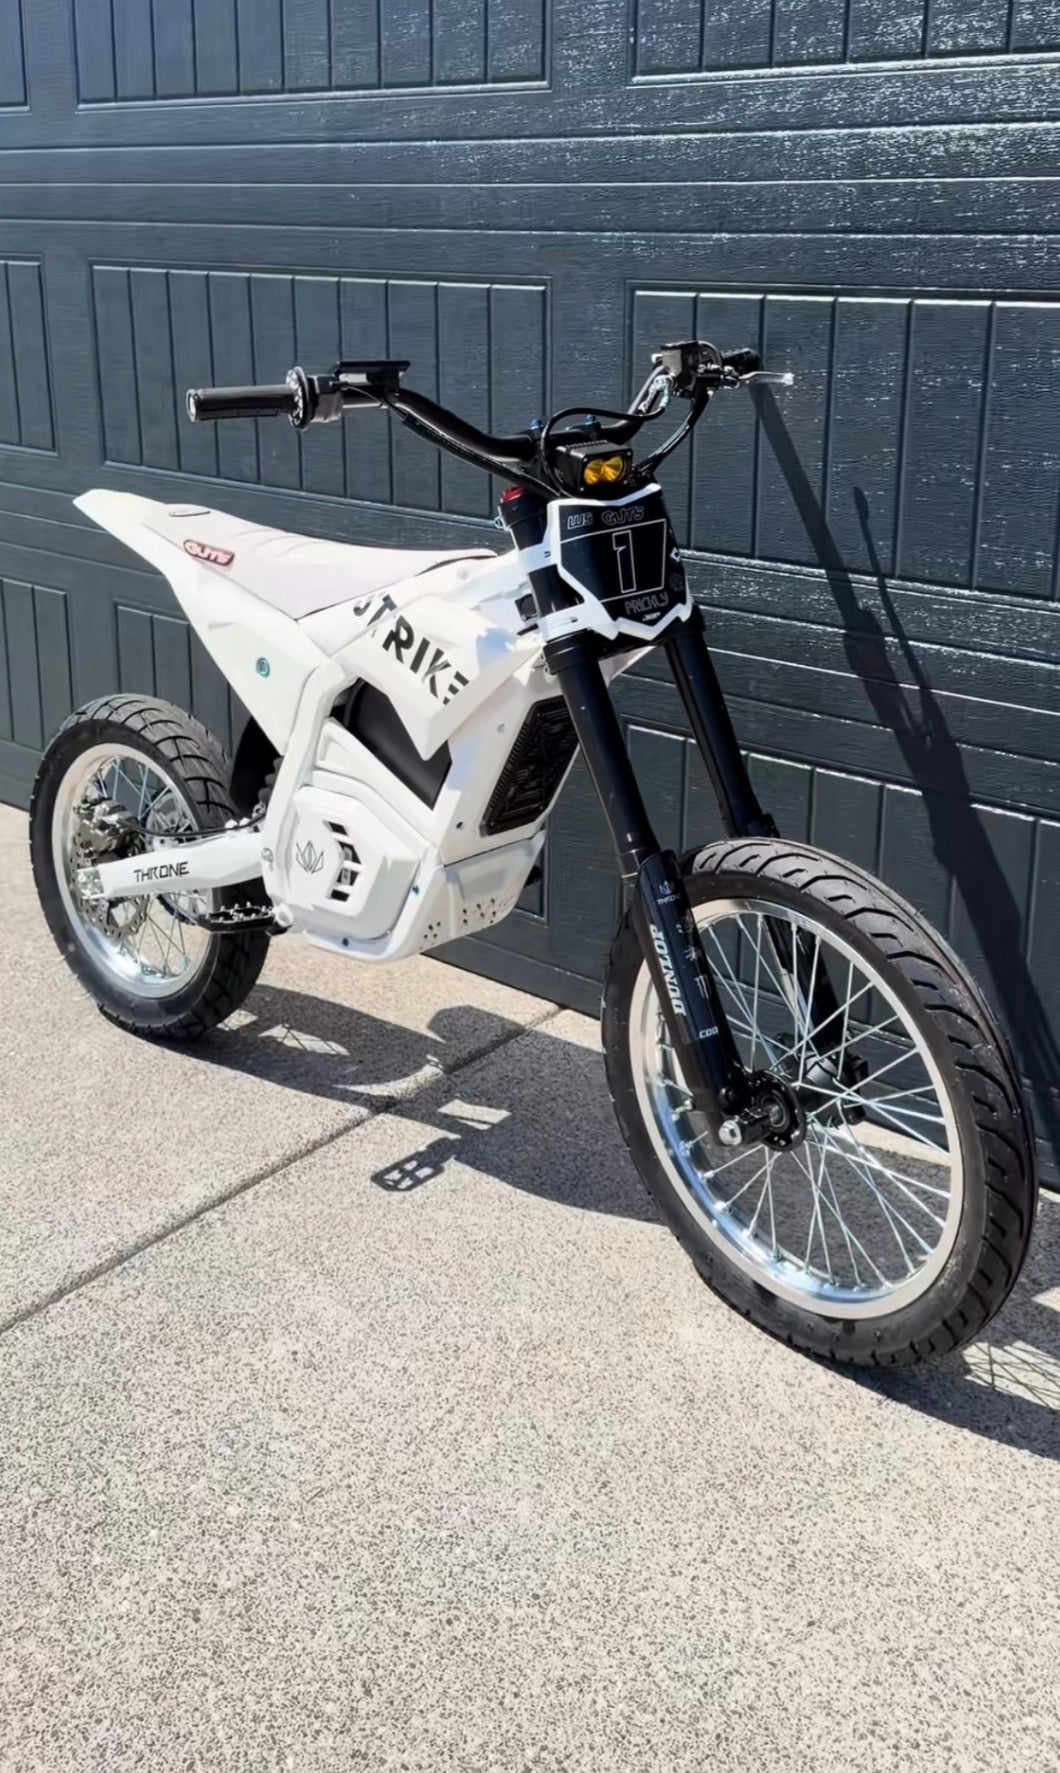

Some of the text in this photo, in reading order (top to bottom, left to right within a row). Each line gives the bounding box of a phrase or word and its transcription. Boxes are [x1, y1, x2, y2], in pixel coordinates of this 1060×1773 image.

[612, 530, 637, 594] 1
[134, 862, 189, 883] THRONE
[649, 923, 687, 1017] DUNLOP
